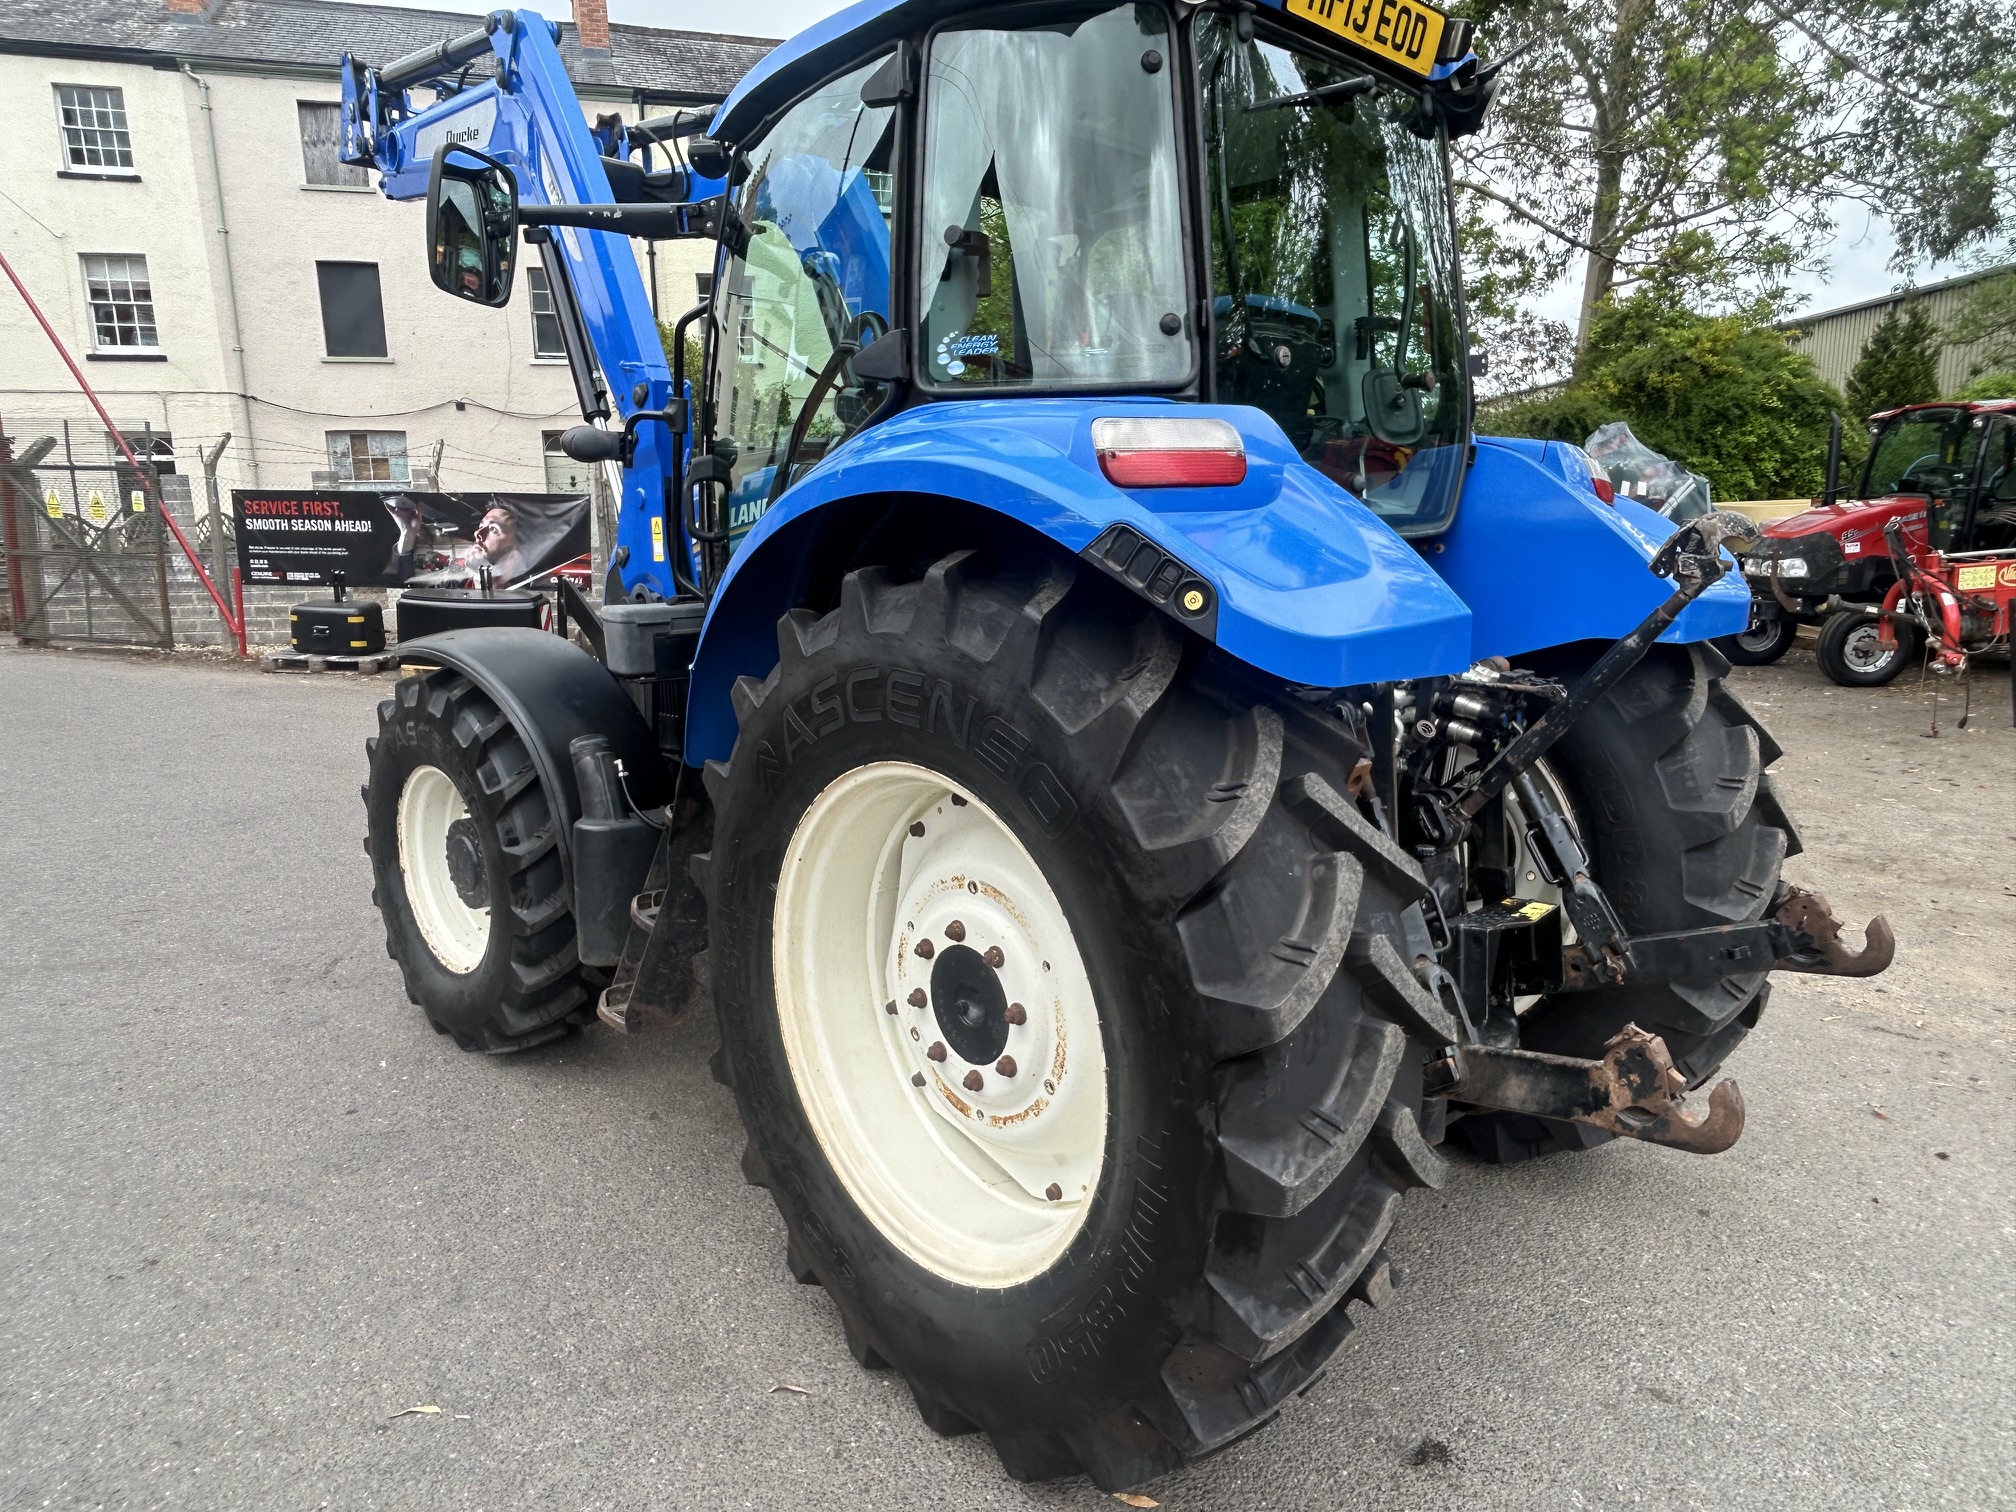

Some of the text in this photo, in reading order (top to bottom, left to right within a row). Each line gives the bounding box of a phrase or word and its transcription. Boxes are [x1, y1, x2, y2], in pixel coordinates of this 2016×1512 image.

[1307, 0, 1428, 60] 13 EOD
[951, 341, 999, 350] ENERGY
[959, 334, 998, 343] CLEAN
[953, 347, 999, 356] LEADER
[244, 500, 344, 518] SERVICE FIRST,
[245, 518, 373, 533] SMOOTH SEASON AHEAD!
[782, 664, 1078, 840] ASCENSO
